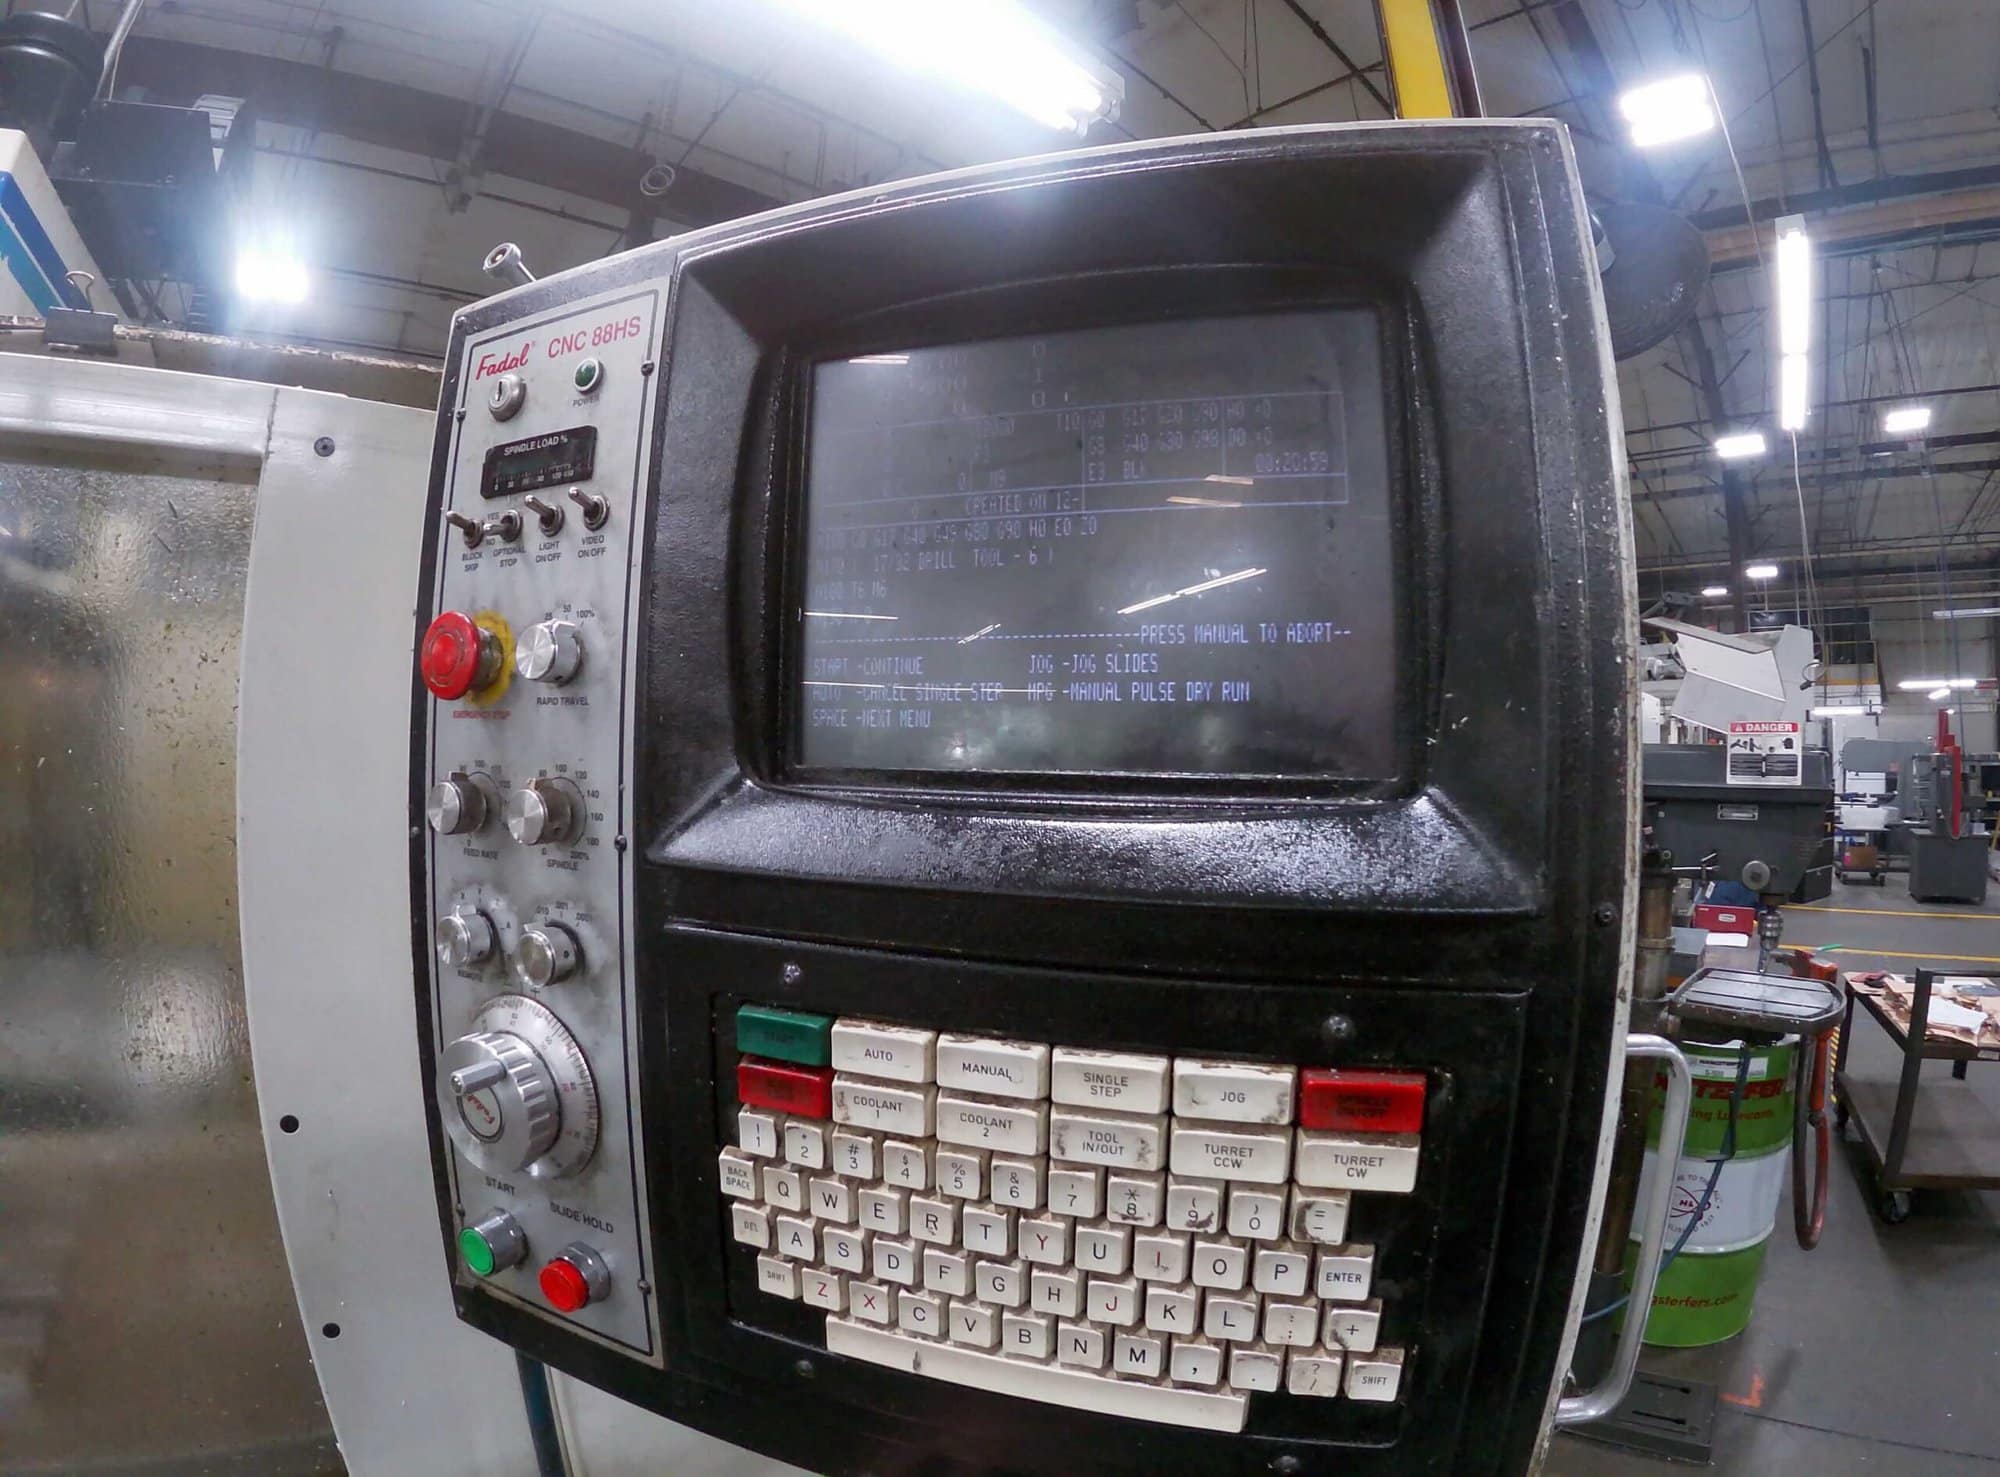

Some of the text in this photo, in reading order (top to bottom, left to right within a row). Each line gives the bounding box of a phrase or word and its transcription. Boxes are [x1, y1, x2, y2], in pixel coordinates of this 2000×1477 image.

[548, 316, 641, 358] CNC 88HS
[475, 343, 530, 380] Fadal
[503, 441, 536, 456] SPINDLE
[537, 436, 559, 449] LOAD
[539, 540, 561, 551] LIGHT
[581, 534, 605, 545] VIDEO
[462, 552, 483, 562] BLOCK
[500, 558, 518, 568] STOP
[973, 548, 1005, 567] TOOL
[1194, 623, 1249, 644] MANUAL
[1259, 623, 1277, 643] TO
[1028, 655, 1053, 674] JOG
[1105, 653, 1158, 673] SLIDES
[971, 682, 1004, 702] STEP
[1131, 681, 1176, 702] PULSE
[1186, 681, 1213, 701] DRY
[1222, 681, 1250, 701] RUN
[537, 696, 590, 706] RAPID TRAVEL
[813, 708, 848, 727] SPACE
[900, 709, 932, 728] MENU
[1746, 723, 1793, 732] DANGER
[587, 790, 600, 799] 140
[864, 1048, 894, 1063] AUTO
[961, 1061, 1009, 1079] MANUAL
[1083, 1071, 1129, 1088] SINGLE
[1090, 1084, 1122, 1098] STEP
[1220, 1091, 1246, 1105] JOG
[853, 1094, 903, 1113] COOLANT
[959, 1111, 1013, 1130] COOLANT
[982, 1126, 990, 1138] 2
[1088, 1130, 1120, 1144] TOOL
[800, 1145, 809, 1159] 2
[847, 1143, 859, 1155] #
[1081, 1140, 1126, 1157] IN/OUT
[1204, 1142, 1254, 1160] TURRET
[849, 1156, 859, 1170] 3
[951, 1162, 966, 1177] %
[1213, 1156, 1243, 1170] CCW
[1333, 1153, 1384, 1169] TURRET
[727, 1166, 749, 1178] BACK
[900, 1167, 910, 1181] 4
[1009, 1171, 1020, 1185] &
[1346, 1166, 1368, 1179] CW
[485, 1176, 516, 1196] START
[726, 1178, 752, 1191] SPACE
[777, 1180, 790, 1198] Q
[953, 1176, 964, 1190] 5
[822, 1191, 839, 1209] W
[1009, 1185, 1020, 1199] 6
[1067, 1194, 1078, 1208] 7
[1126, 1202, 1137, 1216] 8
[551, 1202, 614, 1233] SLIDE HOLD
[873, 1202, 886, 1220] E
[1187, 1209, 1199, 1223] 9
[925, 1213, 939, 1231] R
[790, 1230, 803, 1248] A
[979, 1223, 992, 1242] T
[837, 1240, 850, 1258] S
[1036, 1233, 1049, 1251] Y
[1092, 1242, 1106, 1260] U
[887, 1253, 900, 1270] D
[1212, 1257, 1227, 1276] O
[938, 1263, 952, 1280] F
[1274, 1263, 1289, 1281] P
[1325, 1271, 1362, 1284] ENTER
[817, 1281, 829, 1298] Z
[992, 1275, 1006, 1293] G
[862, 1293, 876, 1310] X
[1048, 1285, 1061, 1303] H
[1105, 1295, 1118, 1312] J
[1162, 1303, 1177, 1321] K
[912, 1306, 926, 1323] C
[1223, 1310, 1236, 1329] L
[963, 1316, 977, 1333] V
[1018, 1328, 1032, 1345] B
[1074, 1338, 1088, 1354] N
[1129, 1347, 1147, 1364] M
[1361, 1375, 1387, 1386] SHIFT
